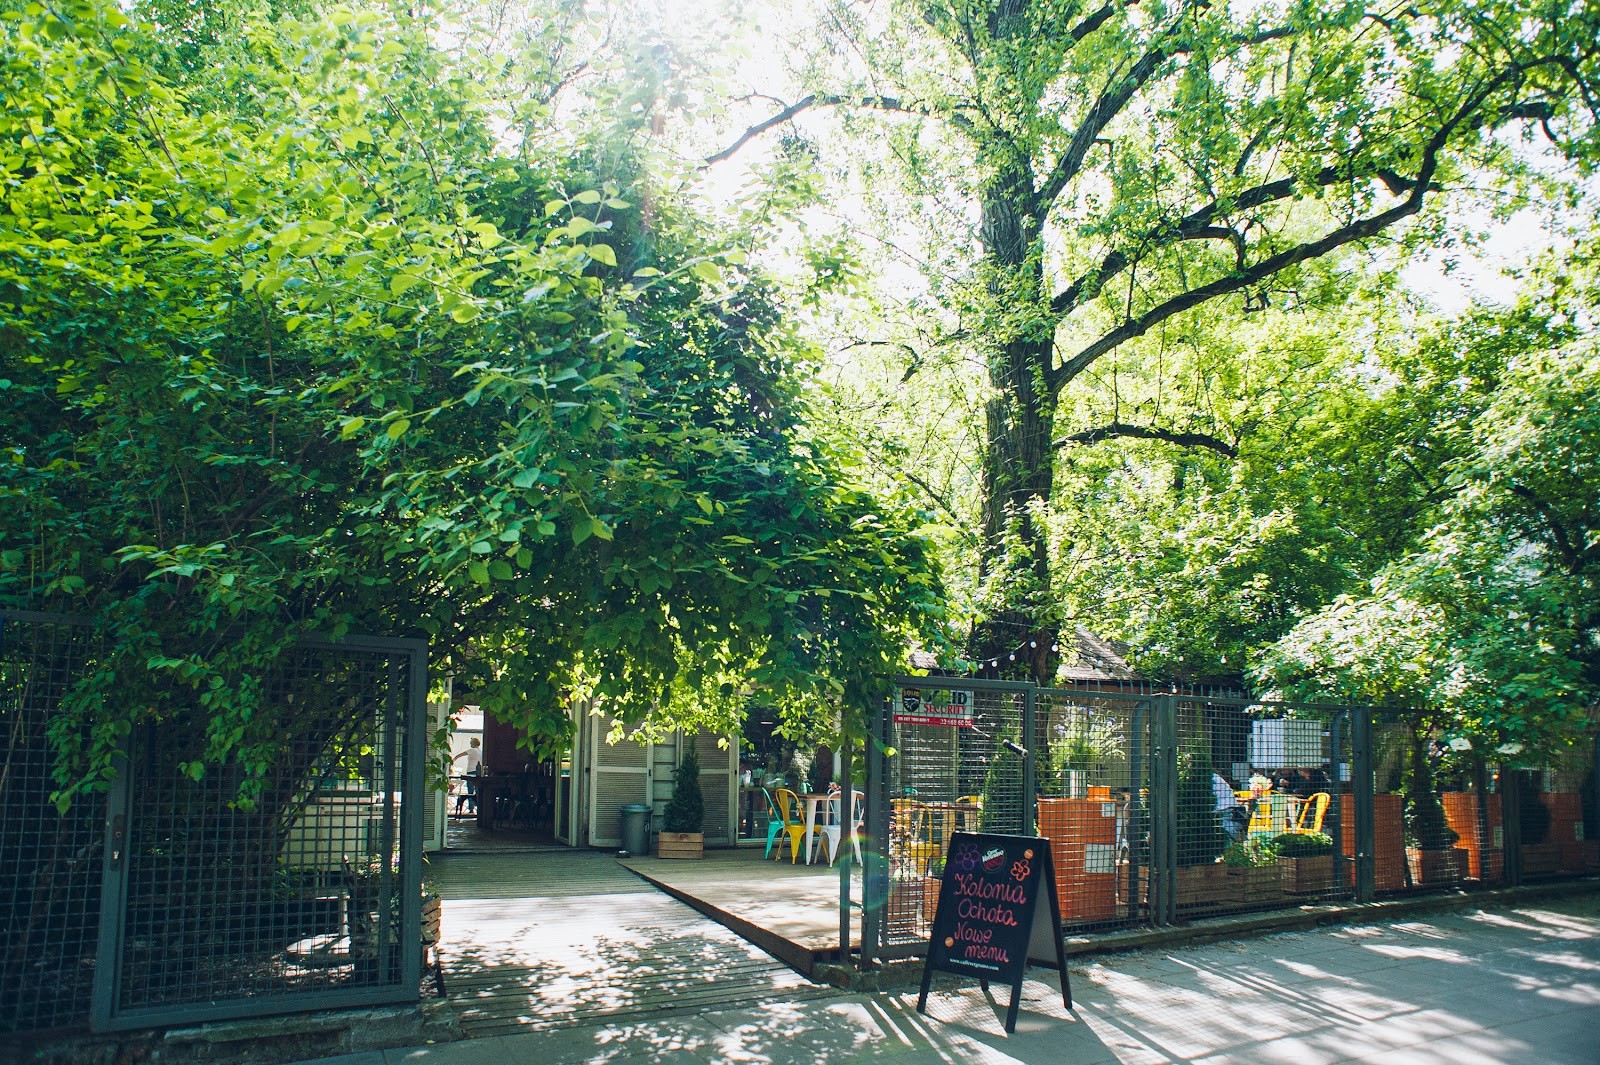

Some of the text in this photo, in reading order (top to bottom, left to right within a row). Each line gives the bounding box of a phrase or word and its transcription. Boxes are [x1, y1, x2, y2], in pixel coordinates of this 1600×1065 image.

[953, 873, 1027, 905] Kolonia
[958, 898, 1018, 926] Ochota
[954, 921, 993, 943] Nowe
[964, 944, 1009, 963] menu
